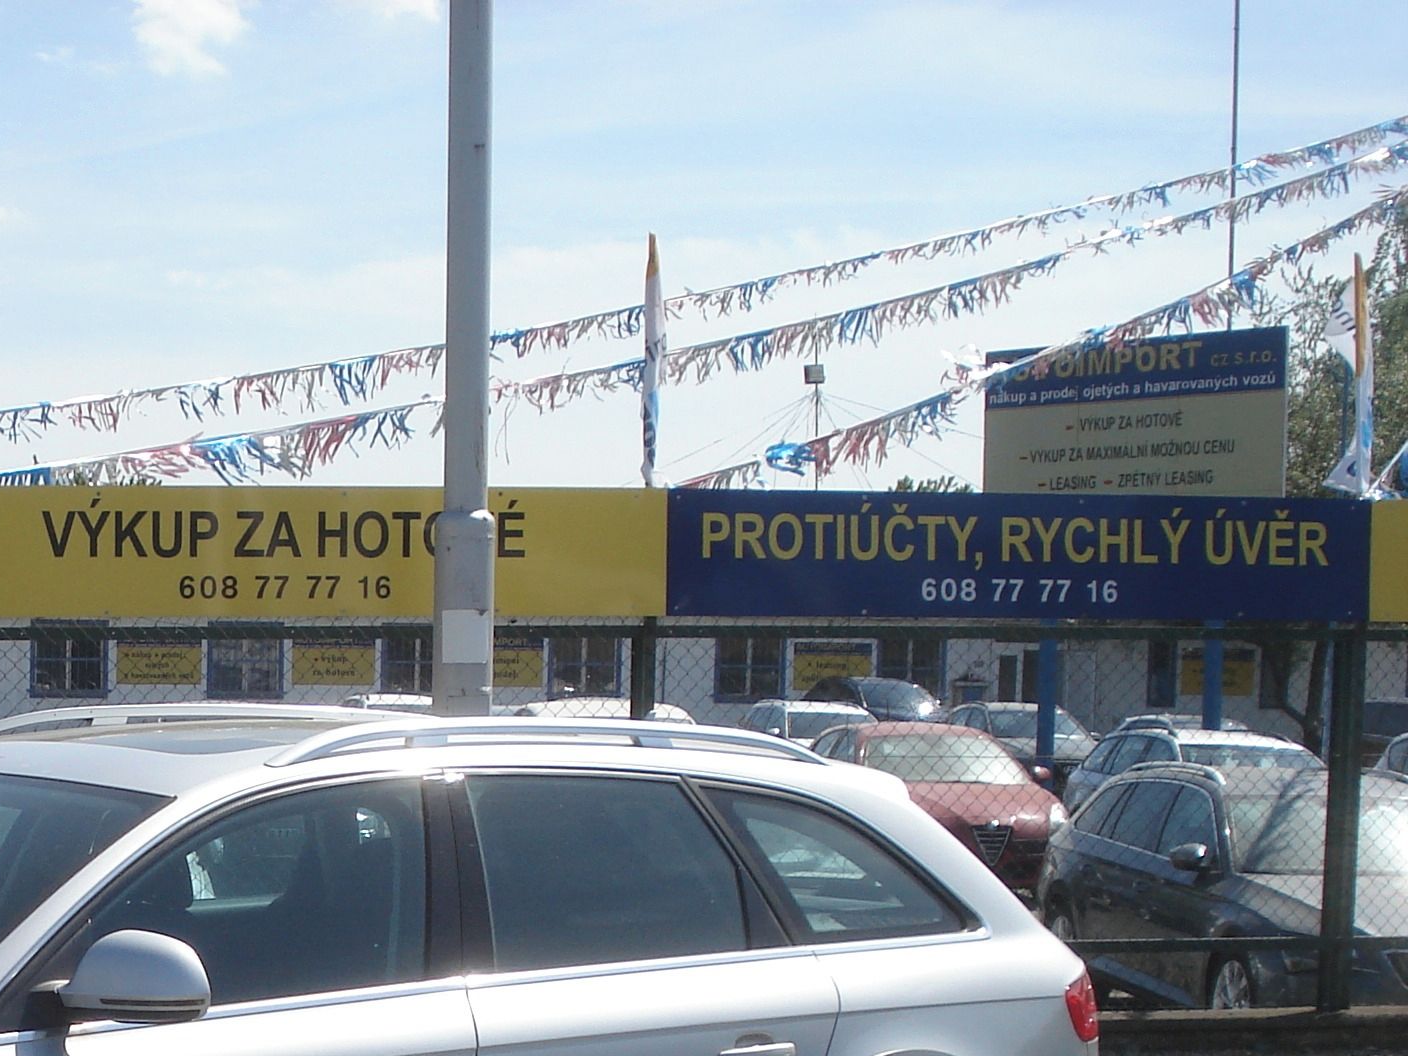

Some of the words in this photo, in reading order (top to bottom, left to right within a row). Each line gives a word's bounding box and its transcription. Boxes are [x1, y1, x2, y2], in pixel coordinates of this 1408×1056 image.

[1030, 393, 1037, 402] a
[1083, 382, 1129, 399] ojetých
[1133, 383, 1141, 394] a
[1145, 375, 1238, 393] havarovaných
[1118, 415, 1133, 430] ZA
[1069, 447, 1084, 462] ZA
[1203, 439, 1235, 455] CENU
[1050, 475, 1097, 491] LEASING
[1165, 469, 1214, 486] LEASING
[42, 498, 219, 558] VÝKUP
[234, 511, 302, 558] ZA
[318, 500, 525, 558] HOTÉ
[702, 503, 983, 570] PROTIÚČTY,
[1001, 508, 1191, 564] RYCHLÝ
[1205, 509, 1328, 566] ÚVĚR
[179, 575, 238, 599] 608
[255, 576, 289, 599] 77
[306, 576, 341, 599] 77
[358, 576, 391, 599] 16
[921, 578, 977, 601] 608
[992, 579, 1024, 602] 77
[1039, 580, 1072, 603] 77
[1087, 580, 1118, 603] 16
